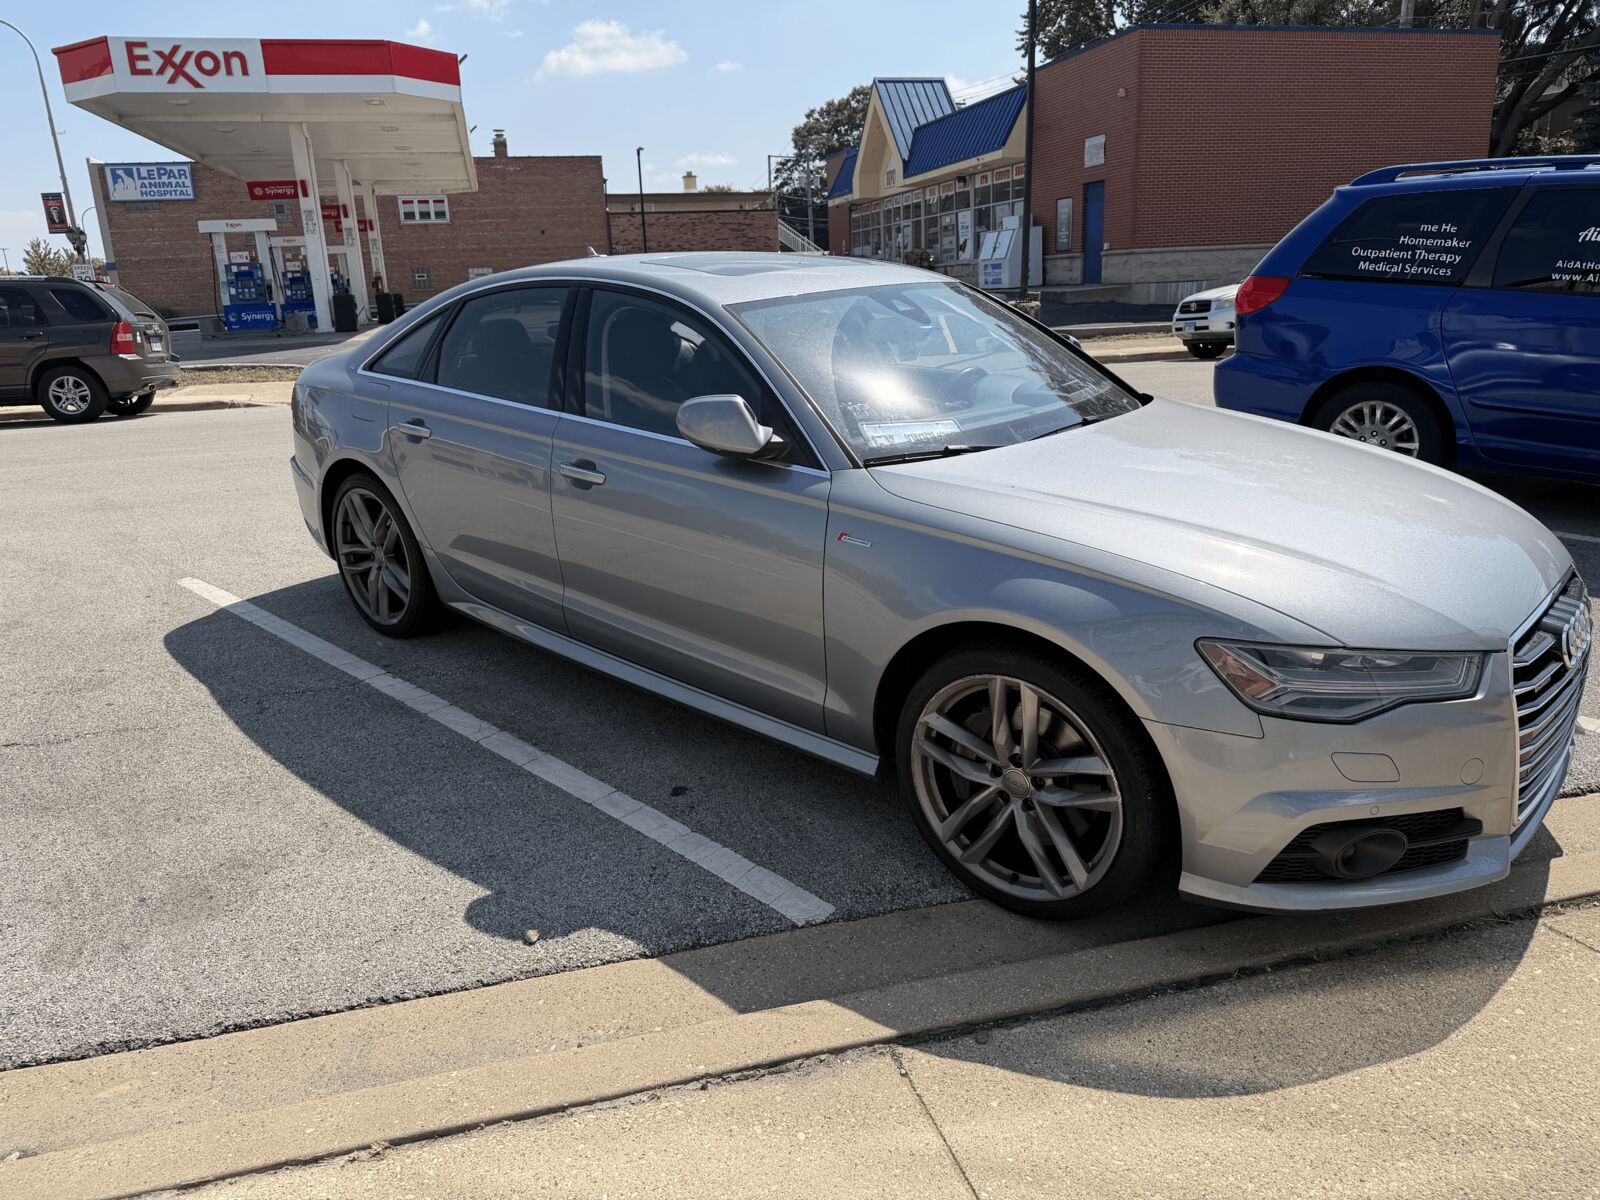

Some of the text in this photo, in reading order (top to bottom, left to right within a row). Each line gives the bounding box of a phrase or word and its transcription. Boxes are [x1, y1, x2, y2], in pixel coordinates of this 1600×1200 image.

[125, 41, 250, 89] Exxon
[140, 181, 190, 189] ANIMAL
[141, 189, 191, 197] HOSPITAL
[265, 187, 294, 195] Synergy
[1420, 223, 1457, 233] me He
[1399, 235, 1472, 248] Homemaker
[1351, 246, 1462, 264] Outpatient Therapy
[1358, 261, 1452, 276] Medical Services
[1552, 273, 1600, 282] www.Ai
[241, 313, 274, 322] Synergy
